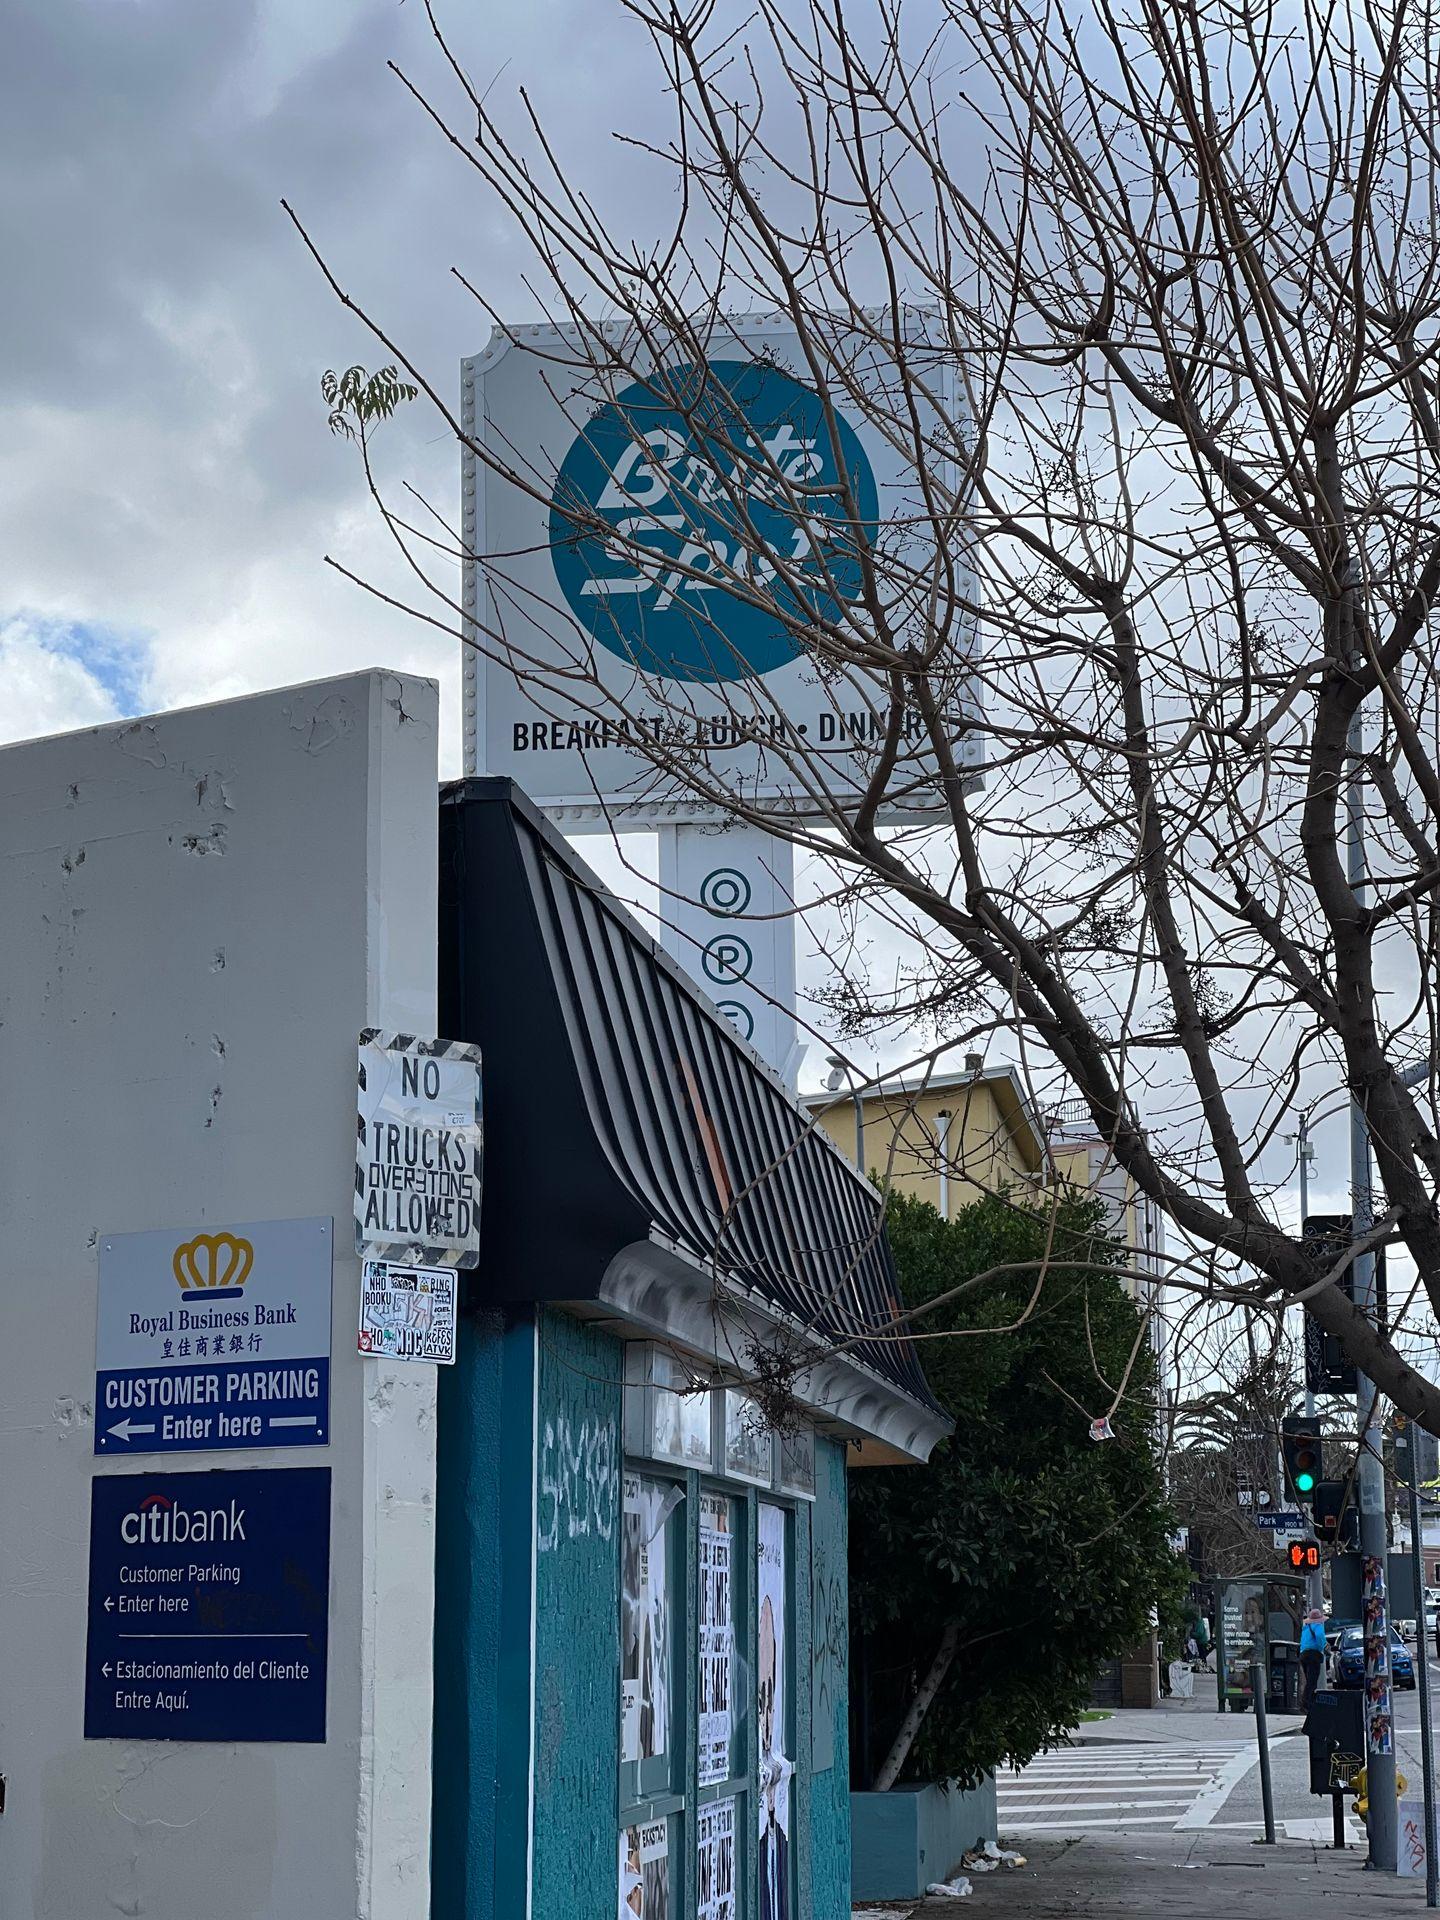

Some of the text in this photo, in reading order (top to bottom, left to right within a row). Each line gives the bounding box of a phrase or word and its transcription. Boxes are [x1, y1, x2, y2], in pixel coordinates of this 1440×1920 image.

[401, 1056, 440, 1100] NO
[373, 1121, 466, 1173] TRUCKS
[364, 1189, 470, 1239] ALLOWED
[129, 1303, 297, 1337] Royal Business Bank
[160, 1332, 263, 1360] 皇佳商業銀行
[105, 1369, 319, 1409] CUSTOMER PARKING
[162, 1412, 262, 1440] Enter here
[121, 1499, 246, 1544] citibank
[1259, 1516, 1277, 1525] Park
[119, 1564, 241, 1584] Customer Parking
[119, 1595, 189, 1613] Enter here
[116, 1661, 309, 1679] Estacionamiento del Cliente
[115, 1690, 190, 1712] Entre Aquí.
